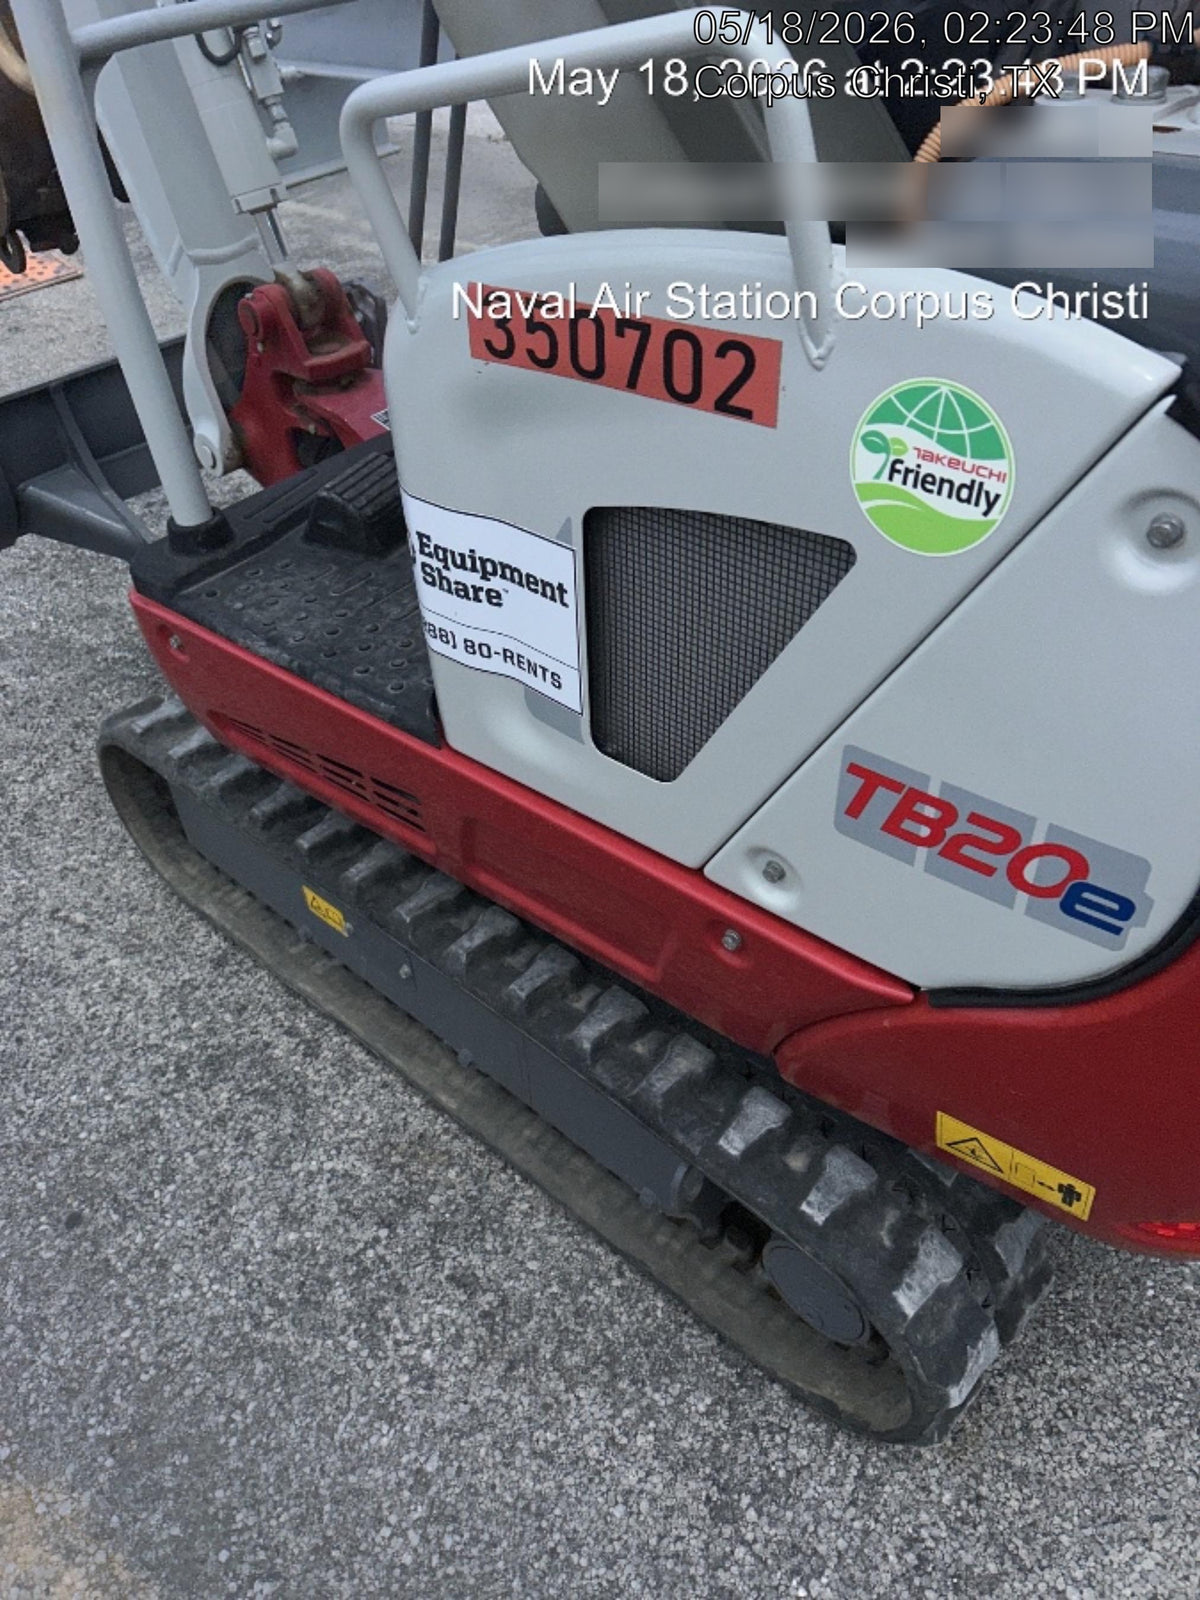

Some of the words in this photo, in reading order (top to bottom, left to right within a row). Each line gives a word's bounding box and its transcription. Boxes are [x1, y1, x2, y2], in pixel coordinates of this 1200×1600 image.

[482, 290, 757, 420] 350702
[416, 531, 569, 608] Equipment
[463, 637, 562, 690] 80-RENTS
[844, 761, 1137, 936] TB20e
